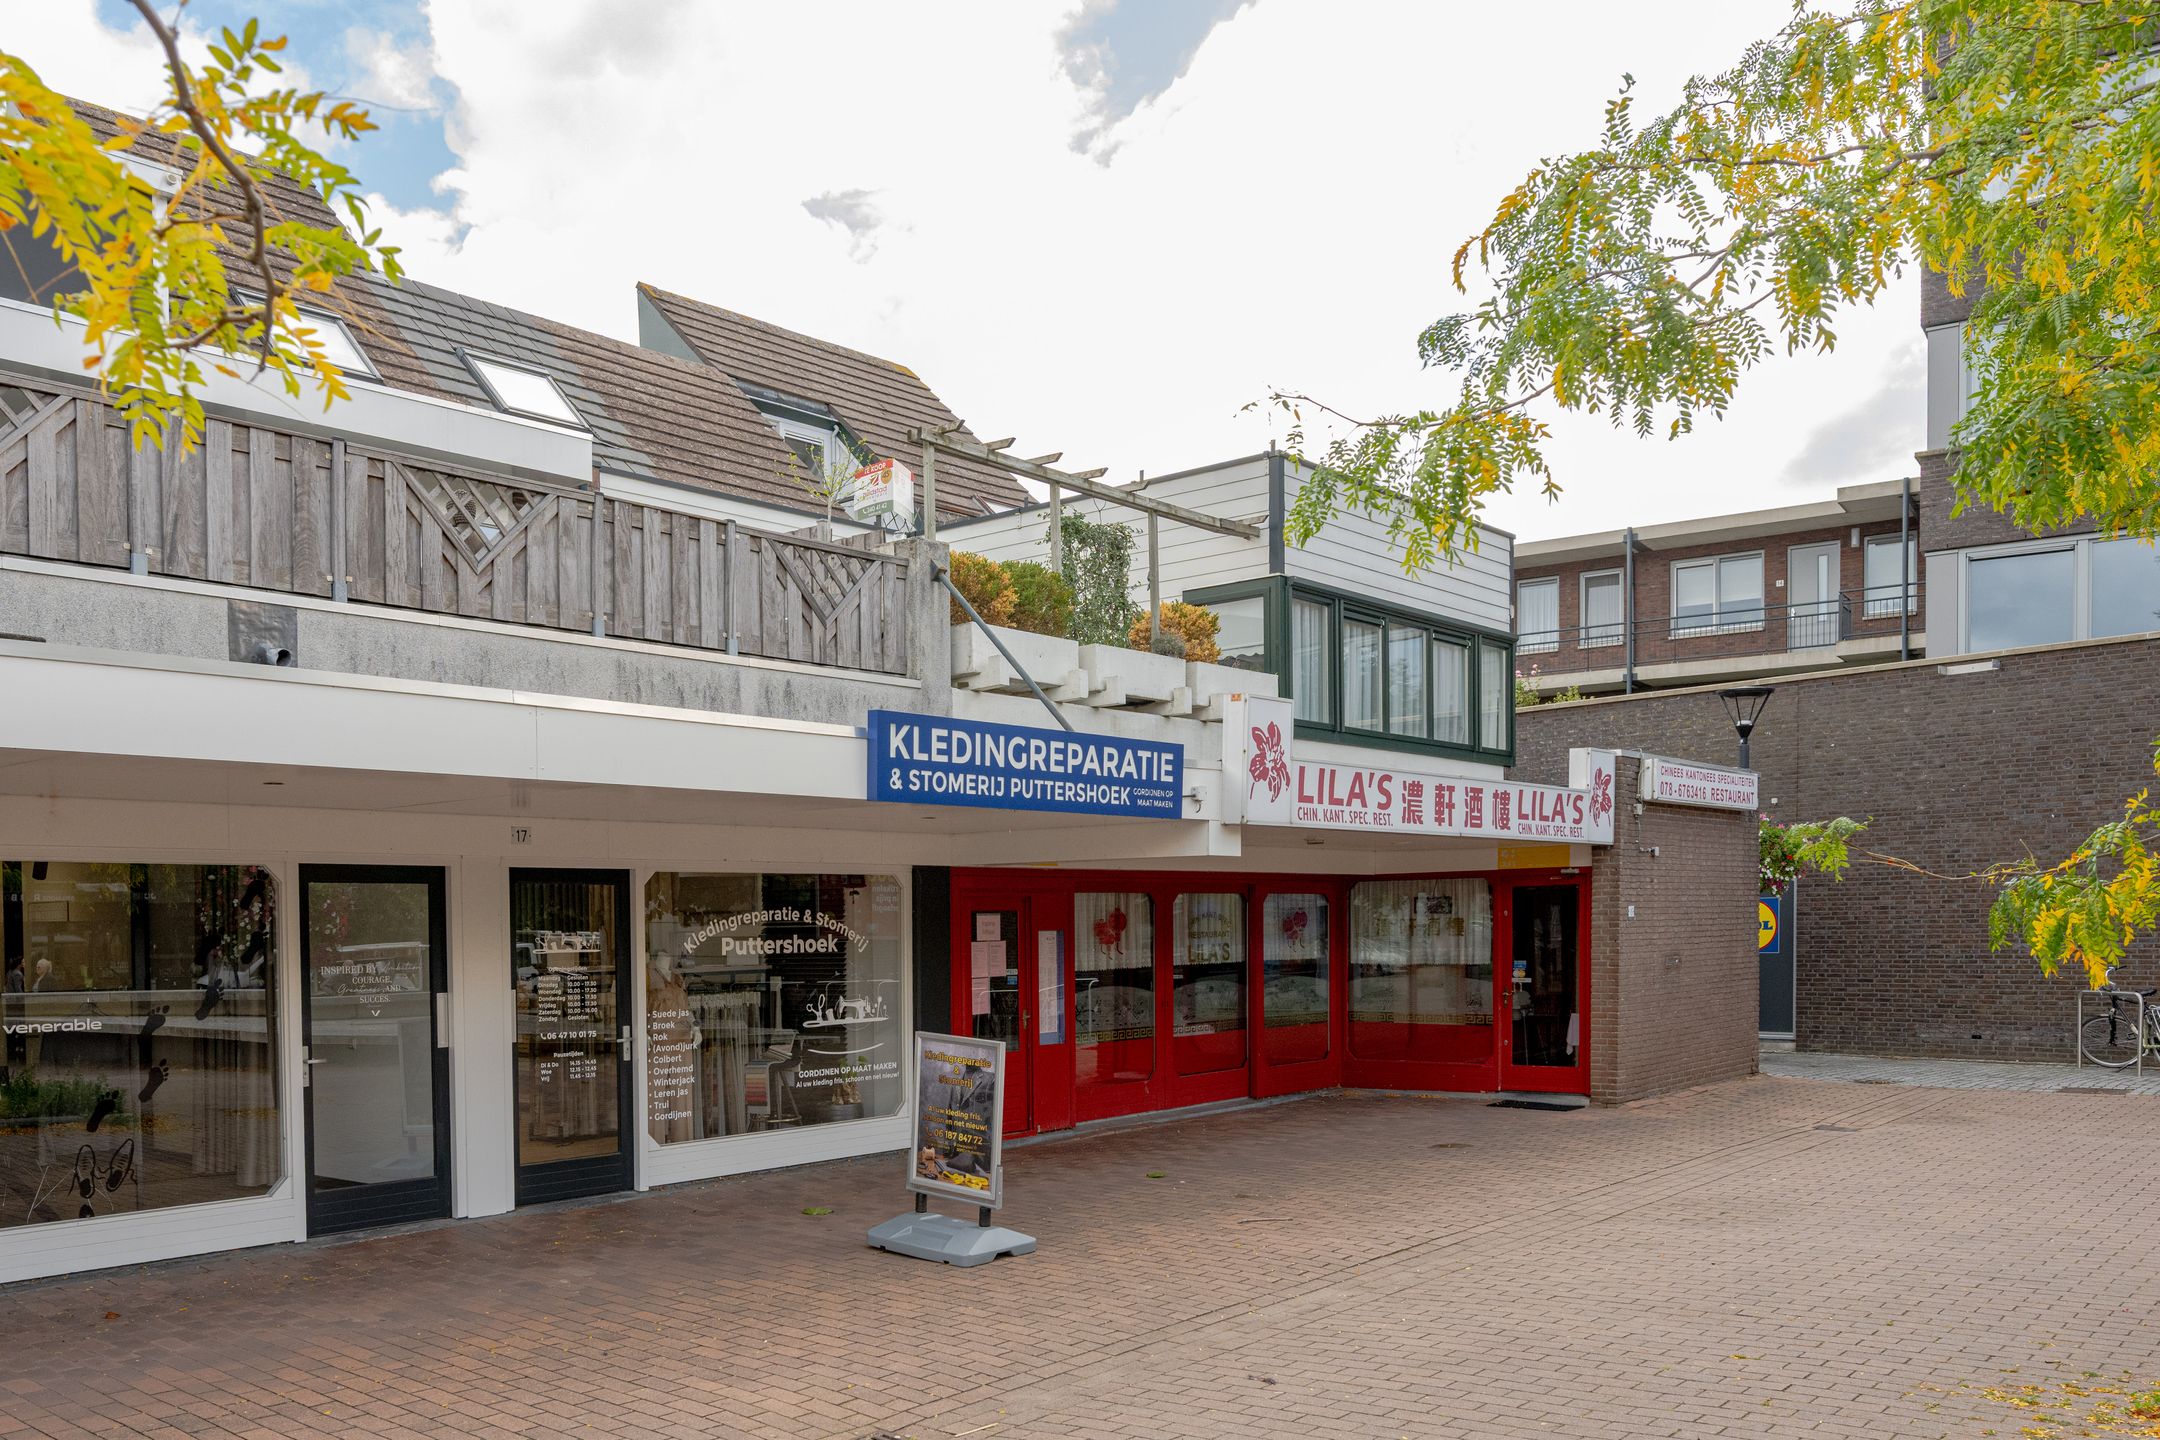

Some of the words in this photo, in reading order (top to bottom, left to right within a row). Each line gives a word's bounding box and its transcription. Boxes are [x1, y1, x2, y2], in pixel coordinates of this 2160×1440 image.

[890, 724, 1174, 782] KLEDINGREPARATIE
[1661, 766, 1683, 778] CHINEES
[1686, 769, 1716, 783] KANTONEES
[1718, 774, 1754, 787] SPECIALITEITEN
[890, 768, 902, 789] &
[909, 770, 1004, 796] STOMERIJ
[1011, 778, 1130, 805] PUTTERSHOEK
[1298, 766, 1392, 811] LILA'S
[1133, 788, 1164, 798] GORDIJNEN
[1711, 788, 1754, 804] RESTAURANT
[1137, 799, 1153, 807] MAAT
[1154, 800, 1173, 808] MAKEN
[1518, 790, 1584, 825] LILA'S
[1298, 807, 1322, 822] CHIN.
[1323, 809, 1347, 824] KANT.
[1349, 810, 1371, 825] SPEC.
[1373, 812, 1393, 827] REST.
[516, 830, 527, 842] 17
[1518, 822, 1534, 835] CHIN.
[1536, 824, 1552, 836] KANT.
[1554, 825, 1569, 837] SPEC.
[1570, 826, 1584, 838] REST.
[683, 907, 800, 954] Kledingreparatie
[803, 909, 812, 923] &
[816, 912, 869, 953] Stomerij
[721, 934, 839, 956] Puttershoek
[321, 965, 363, 975] INSPIRED
[366, 963, 377, 973] BY
[678, 1009, 689, 1018] jas
[2, 1018, 102, 1034] venerable
[653, 1021, 675, 1029] Broek
[653, 1042, 698, 1053] (Avond)jurk
[654, 1055, 681, 1063] Colbert
[654, 1064, 693, 1075] Overhemd
[798, 1068, 839, 1078] GORDIJNEN
[853, 1064, 872, 1073] MAAT
[874, 1062, 897, 1070] MAKEN
[954, 1066, 960, 1075] &
[654, 1076, 695, 1087] Winterjack
[813, 1079, 833, 1087] kleding
[654, 1090, 675, 1098] Leren
[677, 1088, 688, 1097] jas
[654, 1100, 669, 1109] Trui
[655, 1110, 692, 1120] Gordijnen
[946, 1109, 968, 1120] kleding
[934, 1129, 944, 1137] 06
[945, 1130, 957, 1140] 187
[958, 1133, 972, 1142] 847
[973, 1136, 983, 1144] 72
